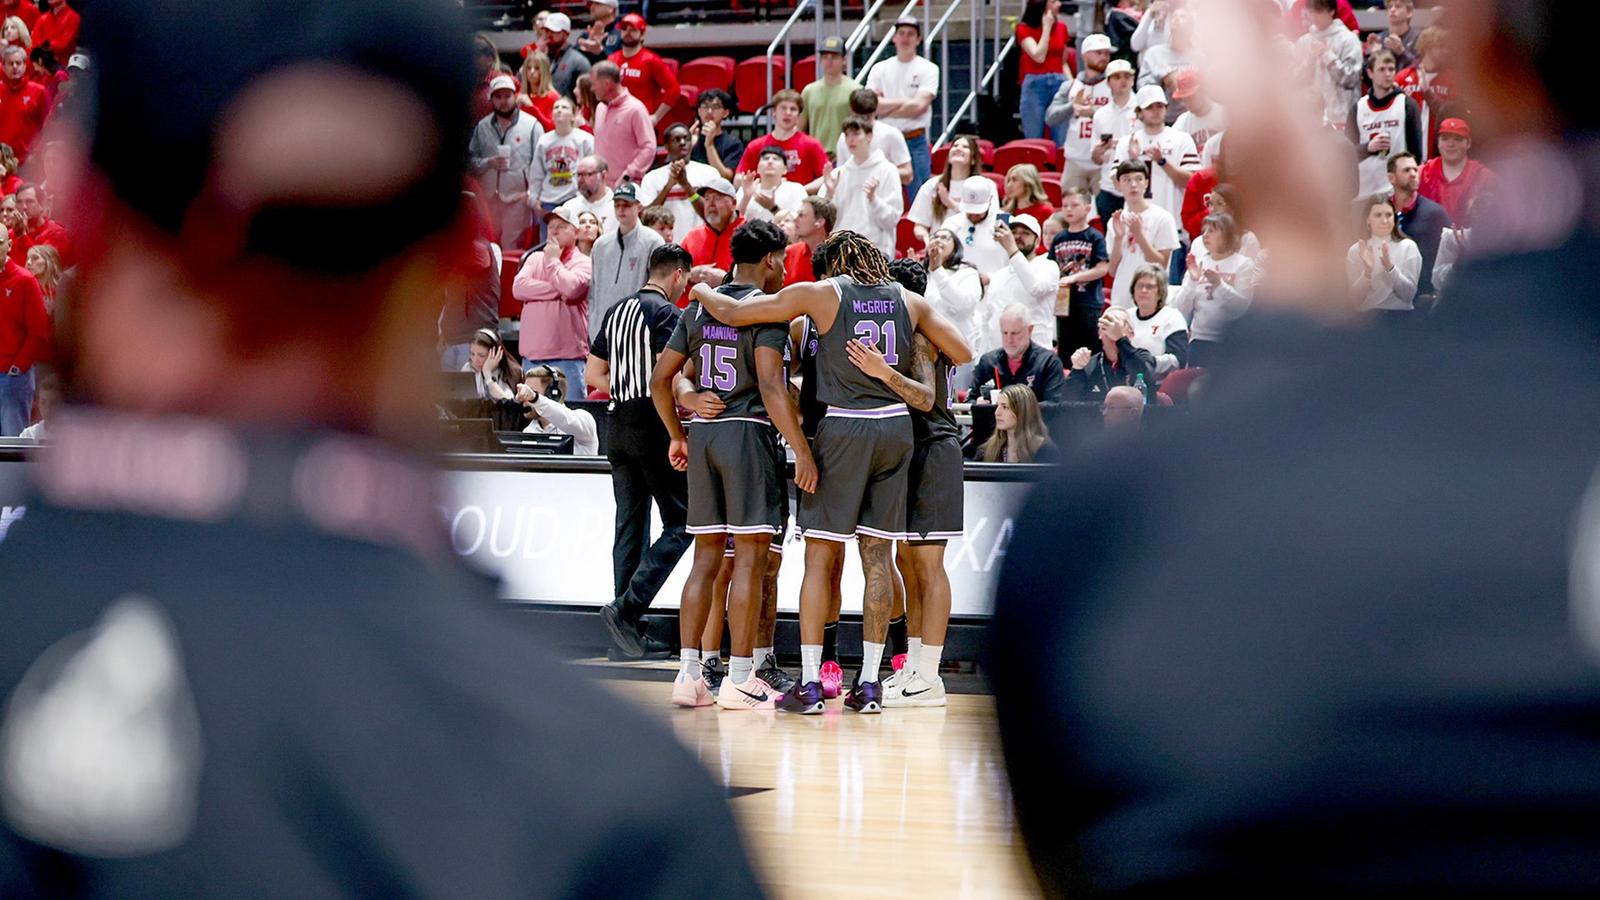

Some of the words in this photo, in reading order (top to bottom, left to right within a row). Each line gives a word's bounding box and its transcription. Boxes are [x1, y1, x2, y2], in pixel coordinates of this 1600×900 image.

[1079, 120, 1093, 139] 15
[852, 299, 896, 314] McGRIFF
[702, 325, 738, 341] MANNING
[854, 320, 899, 366] 21
[699, 343, 737, 392] 15
[451, 505, 560, 559] OUD
